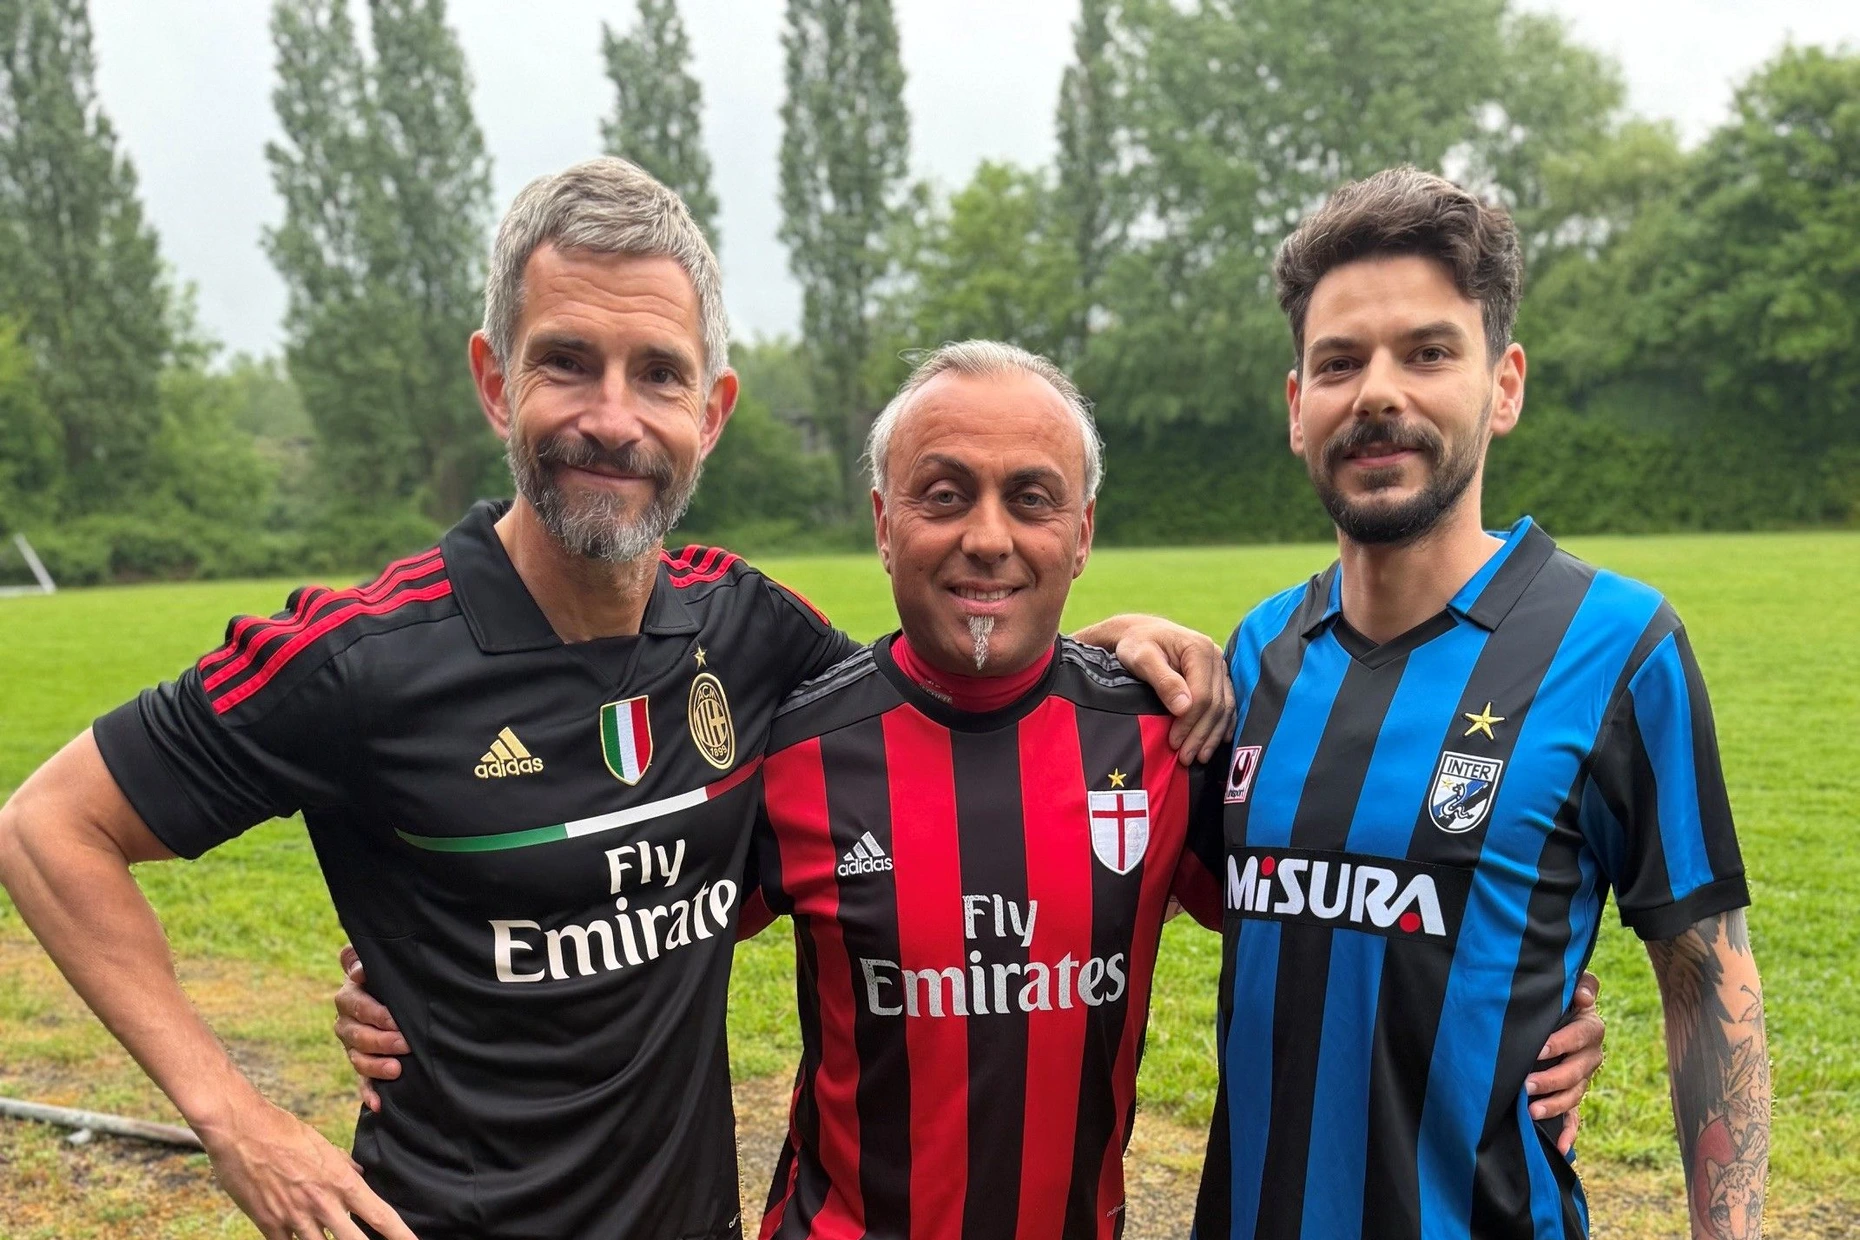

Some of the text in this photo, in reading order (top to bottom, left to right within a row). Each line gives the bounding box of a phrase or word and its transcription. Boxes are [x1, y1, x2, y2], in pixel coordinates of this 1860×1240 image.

[697, 686, 717, 703] ACM
[710, 747, 728, 757] 1899
[474, 756, 544, 779] adidas
[1446, 758, 1492, 780] INTER
[604, 839, 686, 895] Fly
[838, 856, 893, 876] adidas
[488, 879, 737, 983] Emirate
[962, 894, 1038, 947] Fly
[859, 950, 1126, 1017] Emirates
